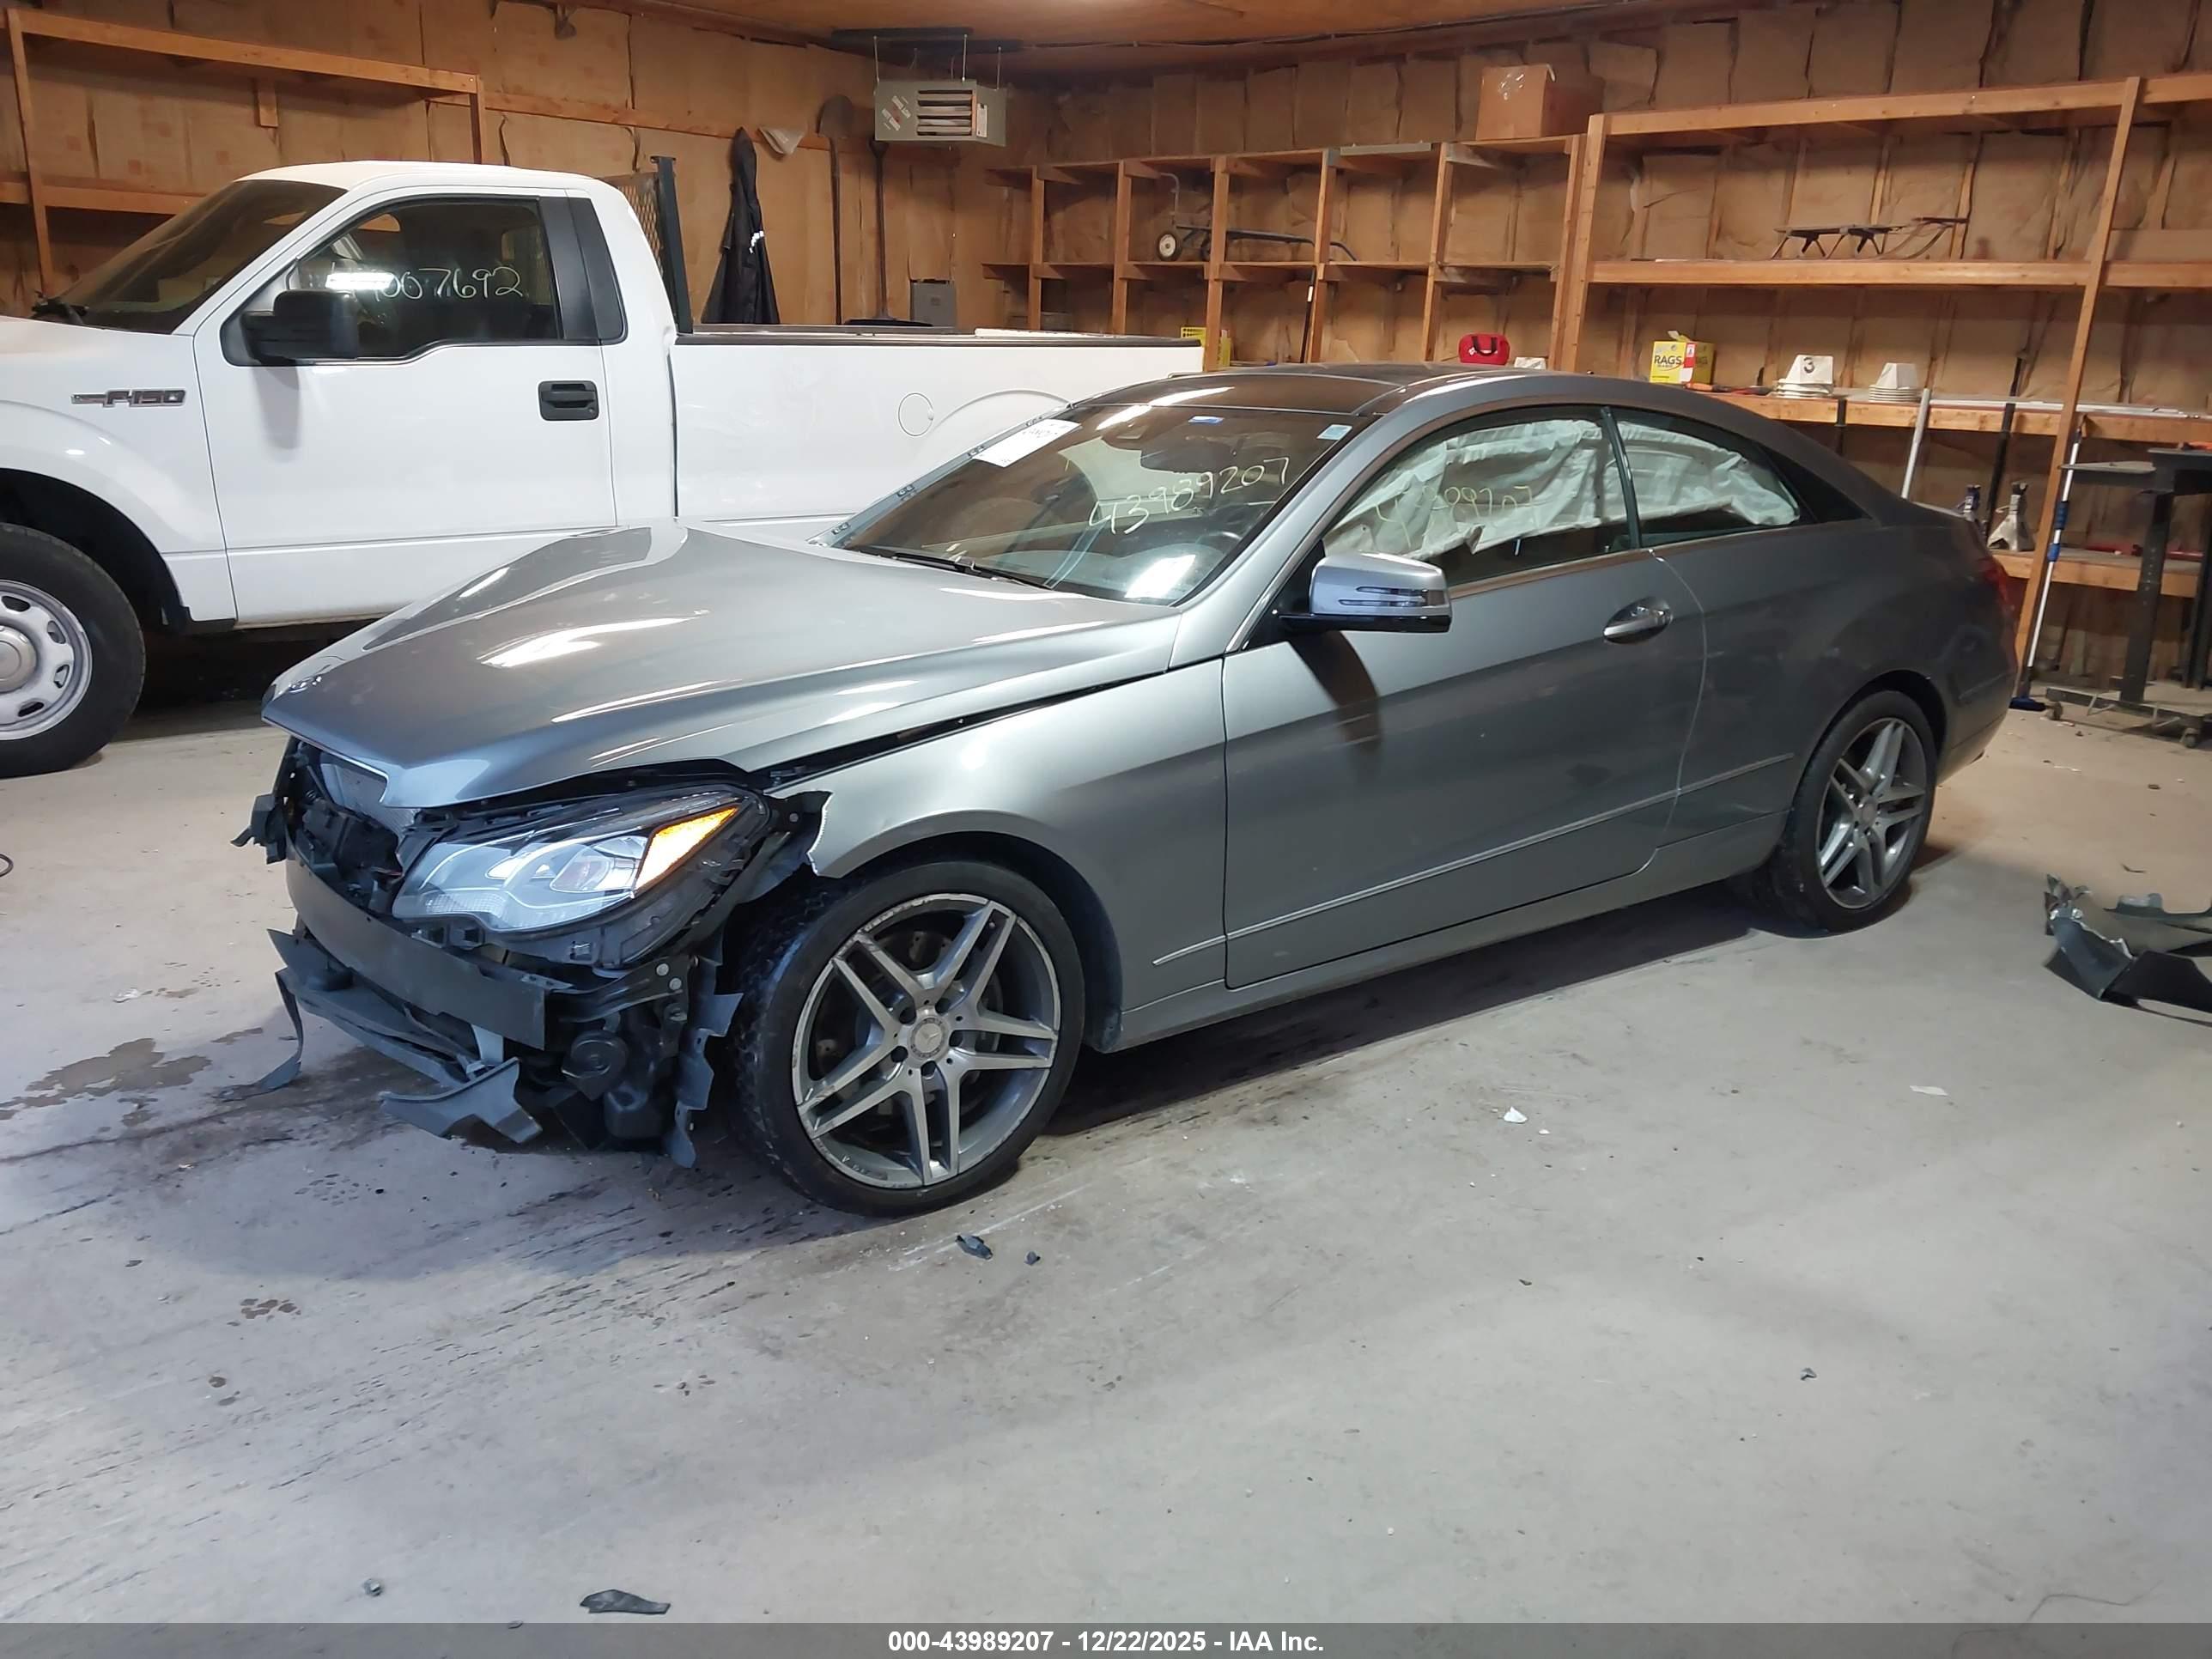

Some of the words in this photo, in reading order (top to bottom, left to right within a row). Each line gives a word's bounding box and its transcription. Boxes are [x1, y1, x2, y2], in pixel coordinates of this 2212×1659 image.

[1654, 354, 1682, 365] RAGS
[1802, 356, 1815, 374] 3
[1088, 456, 1290, 534] 43989207
